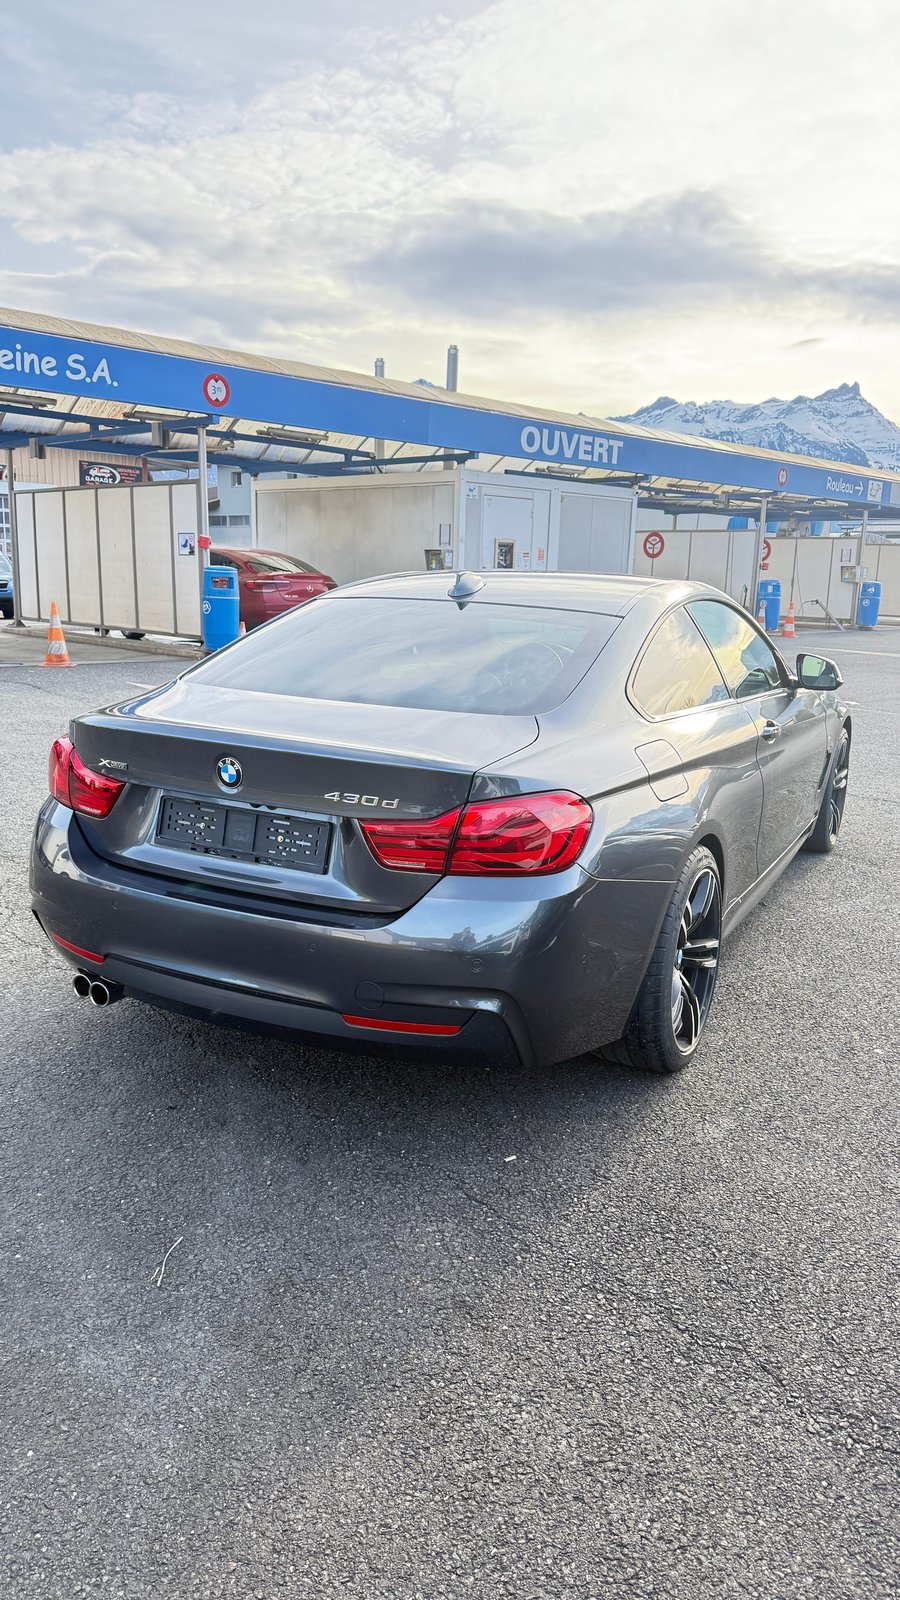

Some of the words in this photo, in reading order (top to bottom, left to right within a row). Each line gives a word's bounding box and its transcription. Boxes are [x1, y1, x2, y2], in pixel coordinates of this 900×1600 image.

[0, 343, 58, 377] eine
[65, 353, 119, 387] S.A.
[520, 425, 624, 465] OUVERT
[85, 475, 114, 484] GARAGE
[826, 476, 854, 494] Rouleau
[324, 791, 400, 809] 430d
